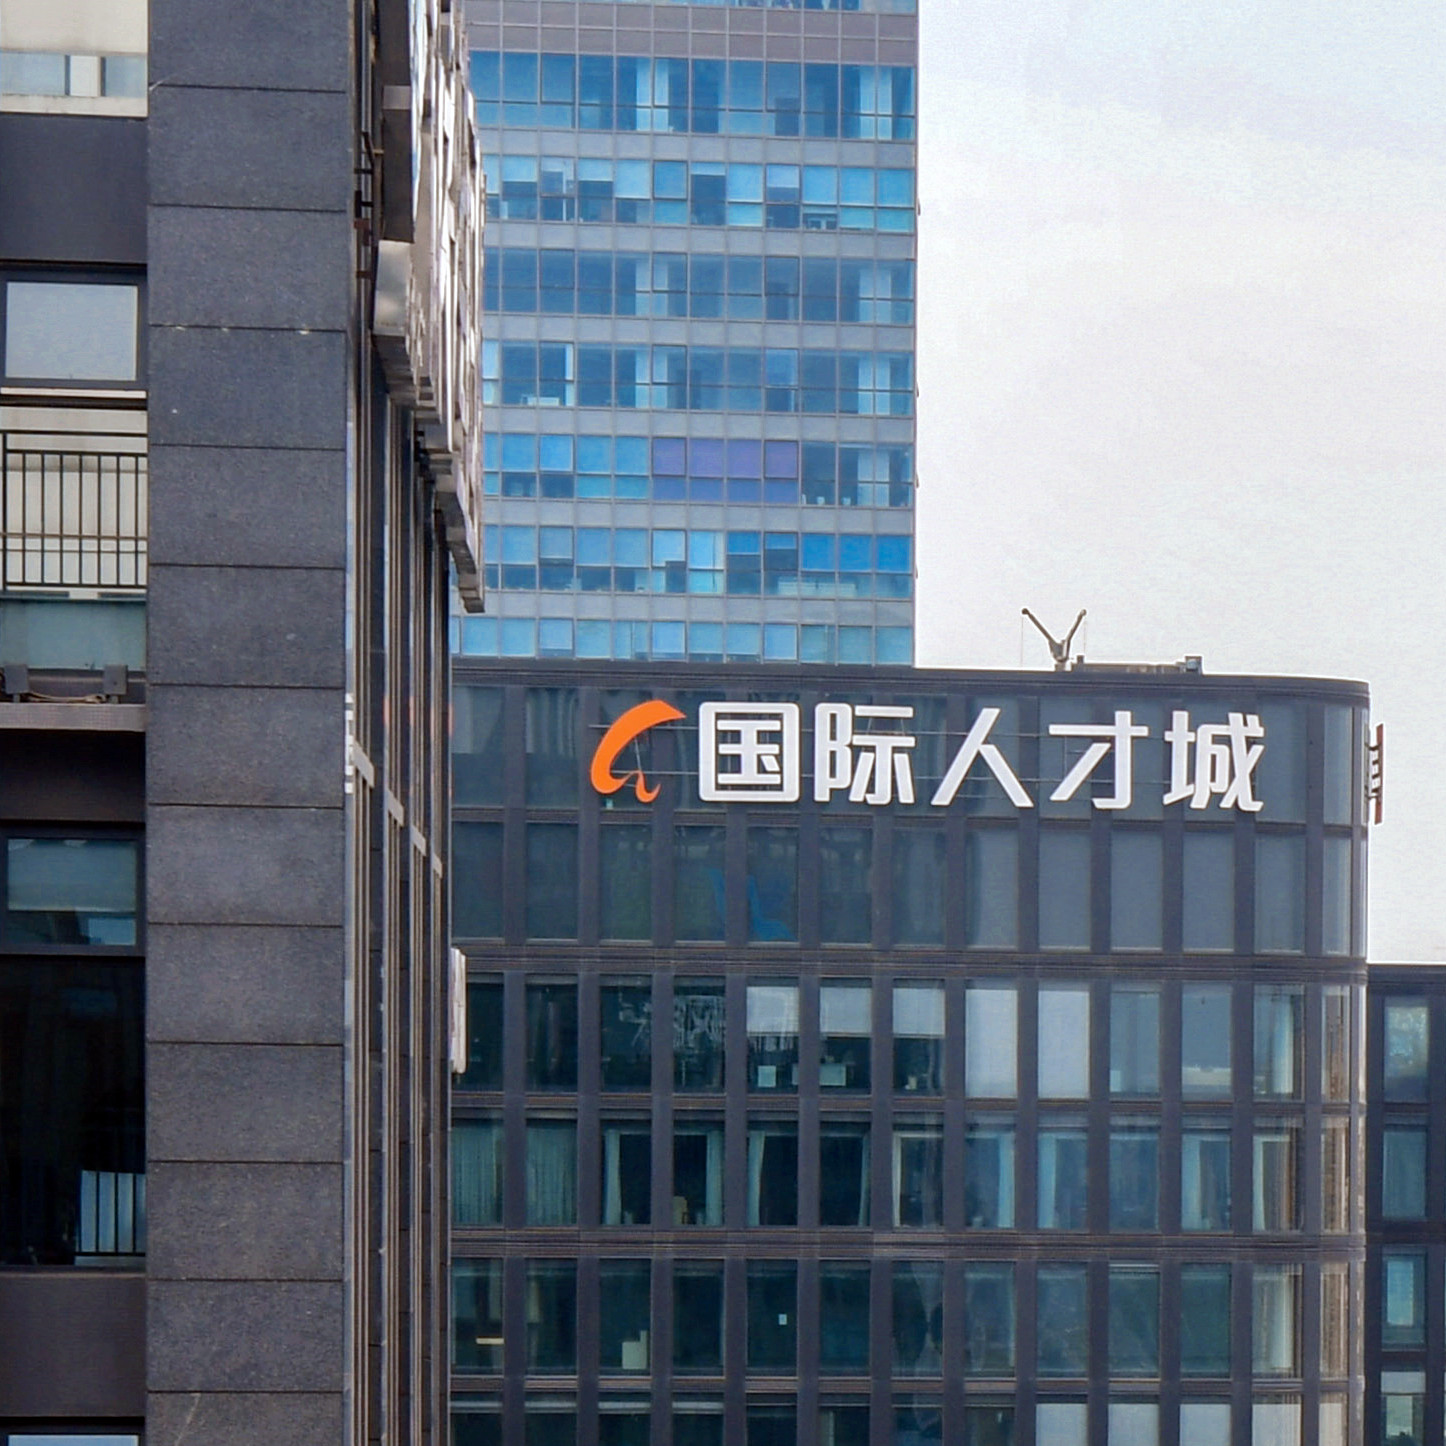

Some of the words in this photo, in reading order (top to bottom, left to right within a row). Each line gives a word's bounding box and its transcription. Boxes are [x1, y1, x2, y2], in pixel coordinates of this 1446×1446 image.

[698, 701, 1265, 812] 国际人才城
